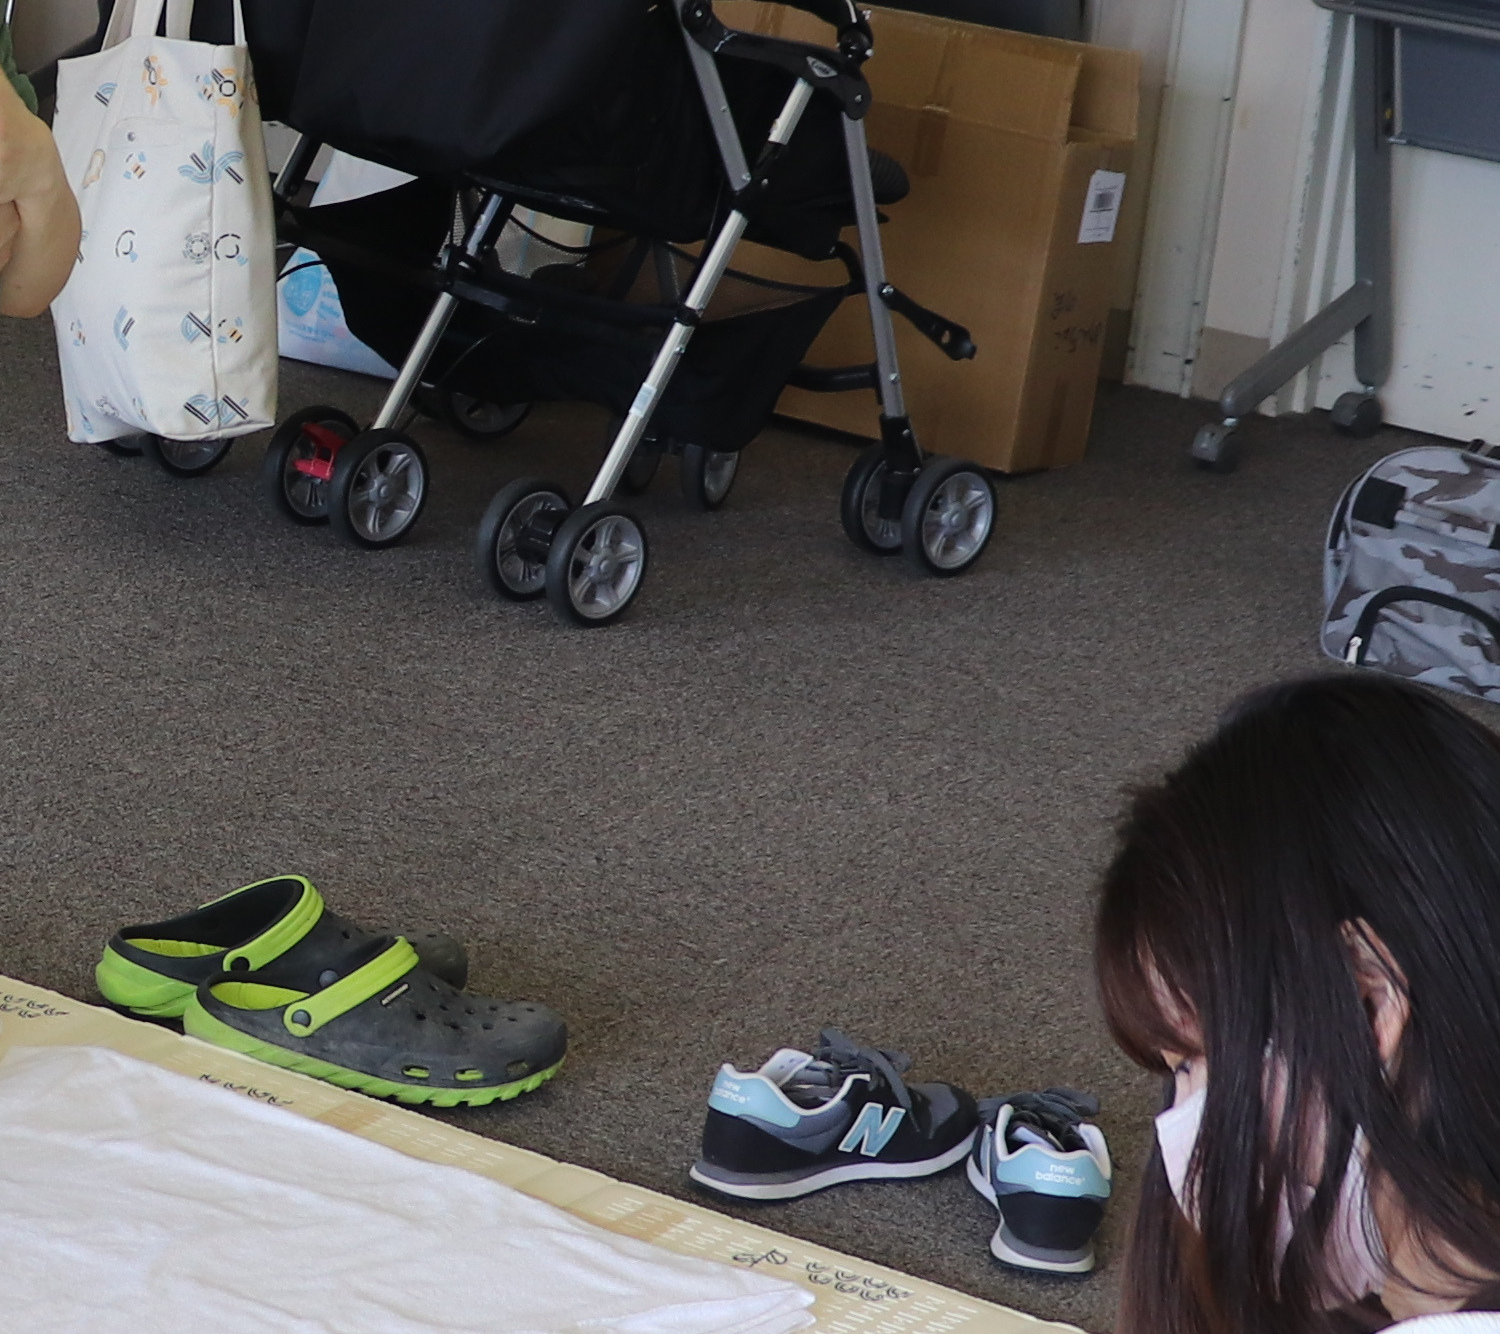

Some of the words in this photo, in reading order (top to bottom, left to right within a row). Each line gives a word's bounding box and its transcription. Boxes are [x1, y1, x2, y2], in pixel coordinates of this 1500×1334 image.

[838, 1102, 906, 1157] N
[1050, 1164, 1075, 1174] new
[1035, 1171, 1083, 1185] balance
